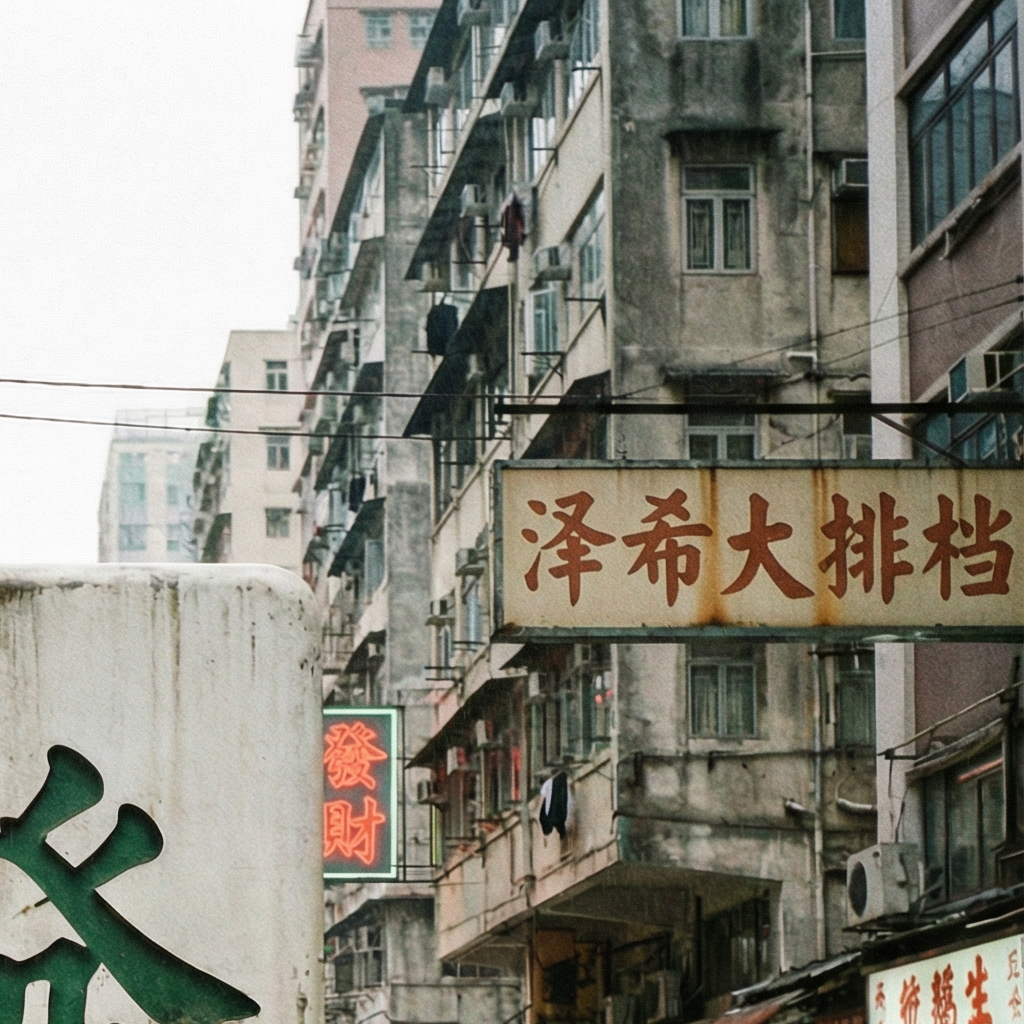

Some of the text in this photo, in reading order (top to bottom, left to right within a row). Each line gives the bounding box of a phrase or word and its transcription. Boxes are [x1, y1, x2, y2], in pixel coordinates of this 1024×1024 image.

[521, 489, 1014, 608] 泽希大排档
[323, 721, 388, 865] 發財
